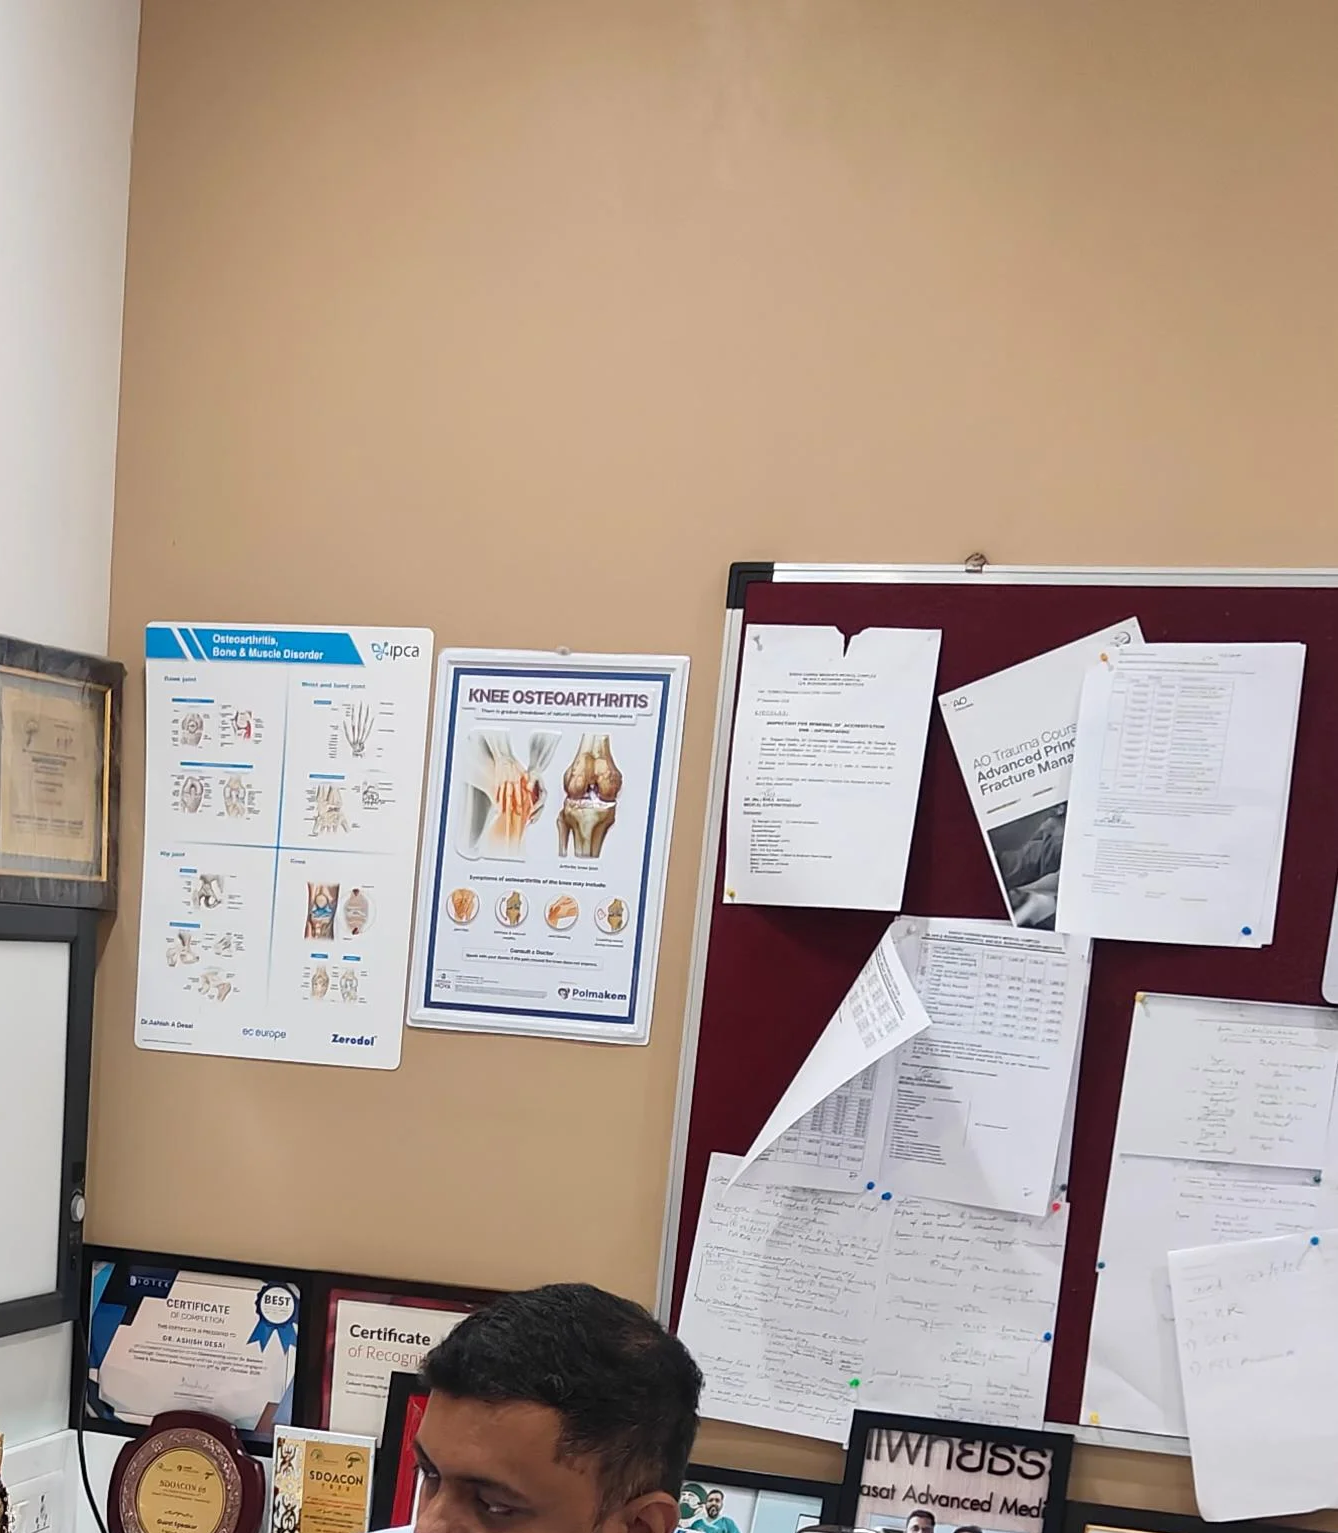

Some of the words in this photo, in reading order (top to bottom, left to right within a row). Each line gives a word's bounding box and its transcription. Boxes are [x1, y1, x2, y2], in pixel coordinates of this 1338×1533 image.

[213, 647, 236, 657] Bone
[239, 648, 246, 657] &
[248, 648, 281, 659] Muscle
[284, 649, 324, 660] Disorder
[468, 689, 509, 703] KNEE
[513, 690, 648, 709] OSTEOARTHRITIS
[973, 754, 991, 769] AO
[993, 738, 1039, 761] Trauma
[978, 749, 1042, 783] Advanced
[980, 768, 1035, 795] Fracture
[1038, 754, 1073, 774] Mana
[255, 1028, 286, 1039] europe
[331, 1034, 376, 1046] Zerodol
[166, 1298, 230, 1315] CERTIFICATE
[264, 1294, 291, 1307] BEST
[180, 1313, 225, 1324] COMPLETION
[177, 1337, 202, 1345] ASHISH
[204, 1340, 225, 1348] DESAI
[350, 1324, 430, 1346] Certificate
[348, 1345, 363, 1357] of
[309, 1470, 363, 1486] SDOACON
[902, 1484, 994, 1512] Advanced
